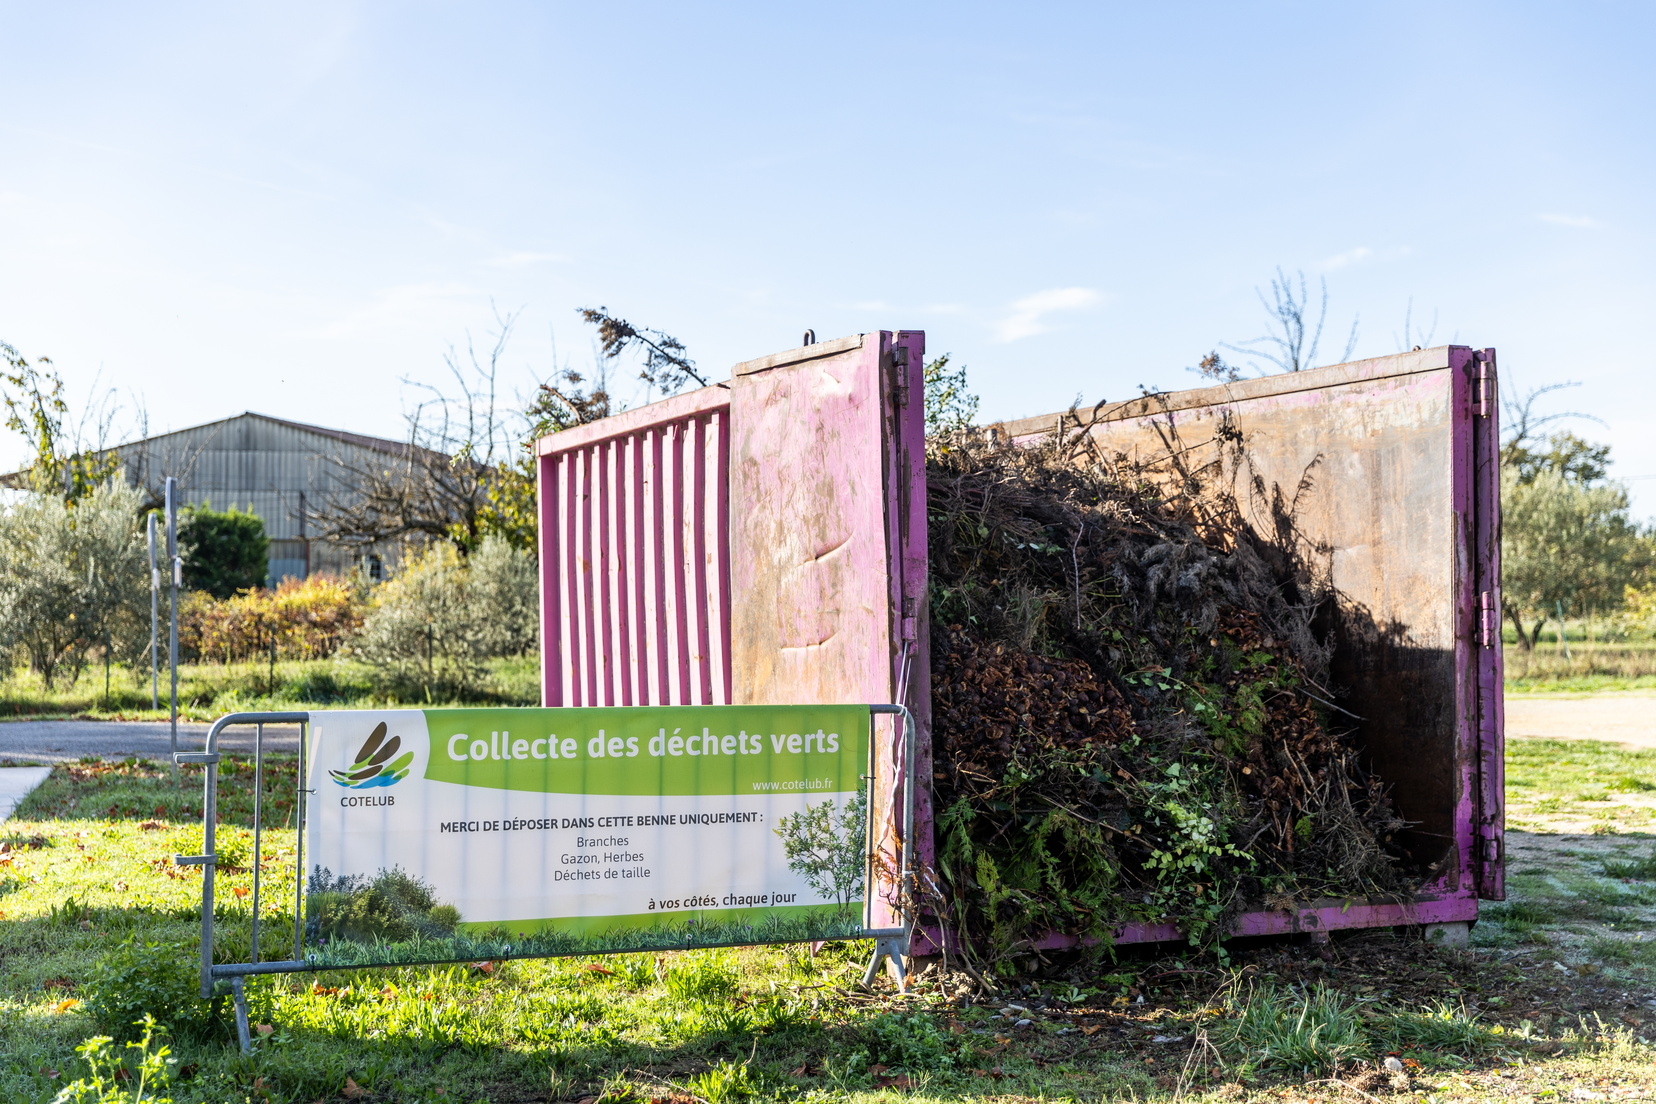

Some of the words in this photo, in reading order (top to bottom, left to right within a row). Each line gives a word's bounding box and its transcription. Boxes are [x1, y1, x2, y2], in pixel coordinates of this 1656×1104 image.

[447, 730, 577, 761] Collecte
[588, 730, 639, 758] des
[648, 727, 762, 757] déchets
[770, 729, 839, 754] verts
[753, 778, 833, 791] www.cotelub.fr
[340, 796, 395, 808] COTELUB
[440, 821, 480, 833] MERCI
[483, 820, 500, 831] DE
[503, 816, 559, 831] DÉPOSER
[562, 816, 595, 829] DANS
[597, 815, 633, 828] CETTE
[636, 814, 677, 826] BENNE
[679, 812, 757, 826] UNIQUEMENT
[576, 835, 629, 848] Branches
[561, 851, 600, 866] Gazon,
[604, 850, 644, 864] Herbes
[554, 868, 601, 881] Déchets
[604, 868, 619, 879] de
[621, 867, 651, 879] taille
[648, 897, 656, 910] à
[659, 899, 680, 910] vos
[683, 894, 719, 910] côtés,
[722, 893, 767, 909] chaque
[769, 892, 797, 907] jour
